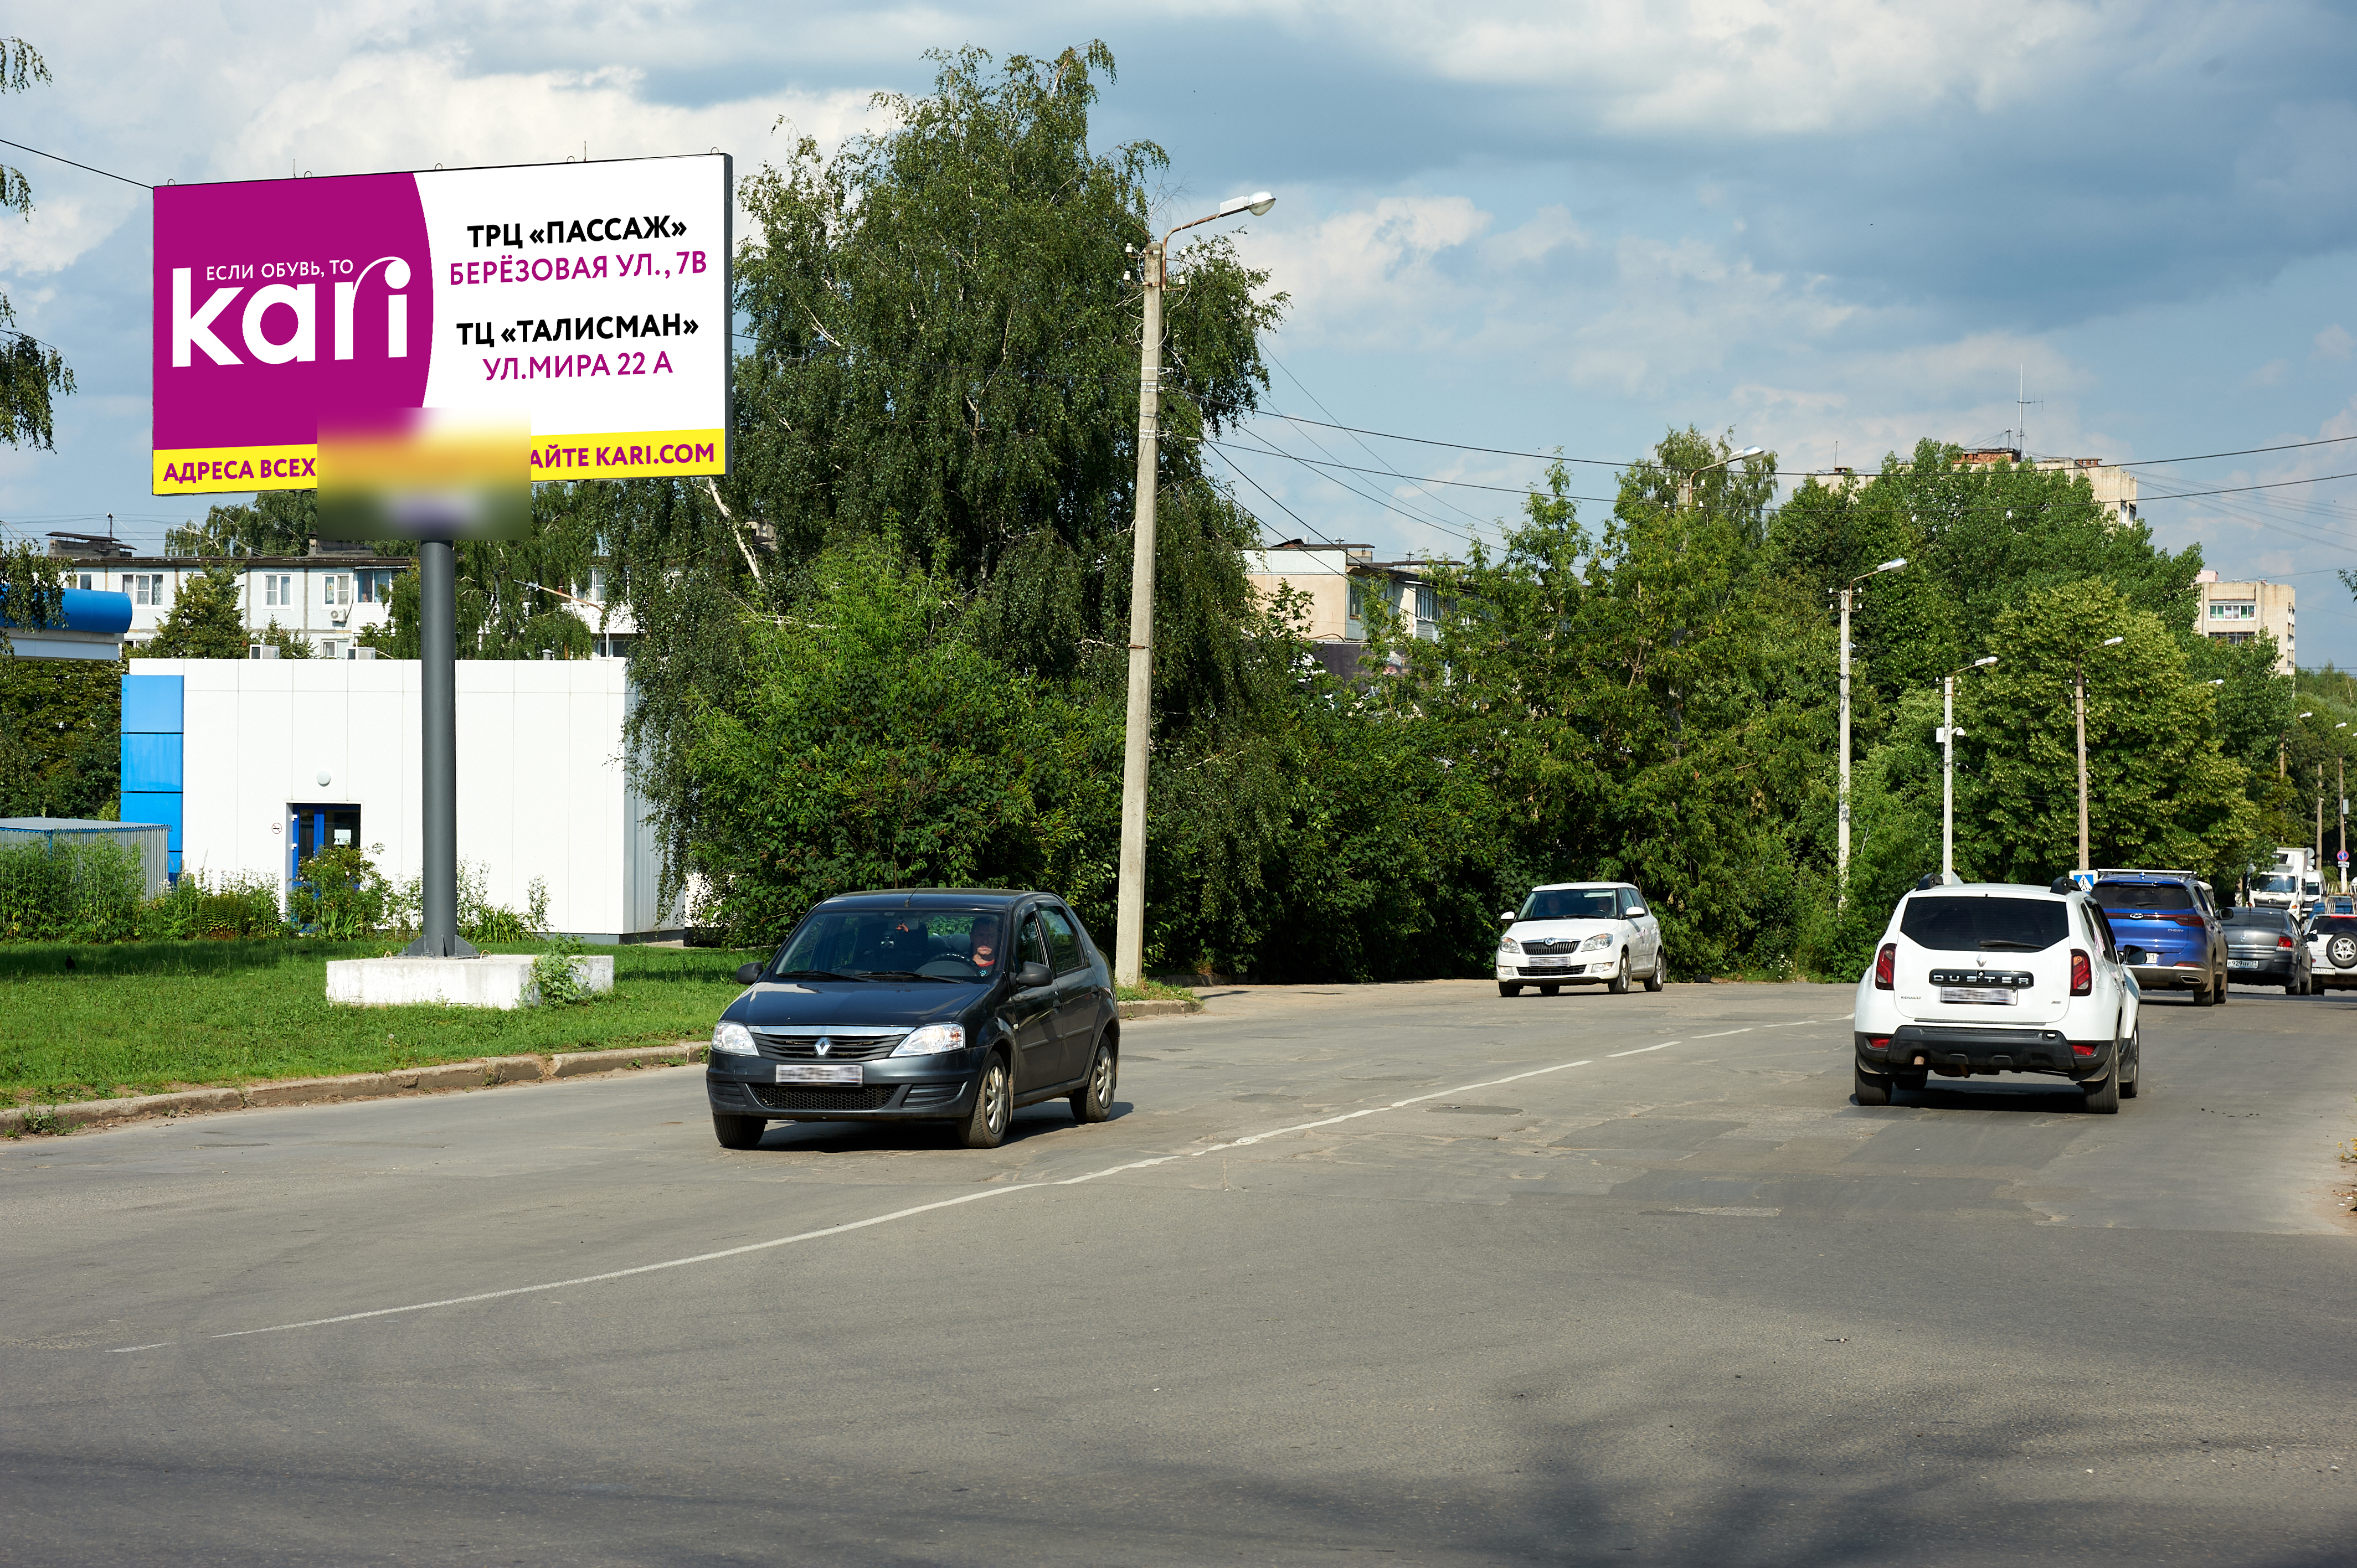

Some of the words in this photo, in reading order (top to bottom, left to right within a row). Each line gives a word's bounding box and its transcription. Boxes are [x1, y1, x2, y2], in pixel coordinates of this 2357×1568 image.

[467, 225, 523, 249] ТРЦ
[529, 220, 687, 245] «ПАССАЖ»
[207, 265, 253, 281] ЕСЛИ
[261, 261, 325, 278] ОБУВЬ,
[329, 259, 353, 276] ТО
[450, 255, 611, 285] БЕРЁЗОВАЯ
[676, 250, 707, 274] 7В
[172, 256, 411, 368] kari
[456, 322, 495, 348] ТЦ
[501, 313, 699, 343] «ТАЛИСМАН»
[617, 352, 646, 375] 22
[652, 350, 673, 374] А
[531, 444, 589, 468] АЙТЕ
[596, 443, 714, 466] KARI.COM
[163, 460, 255, 484] АДРЕСА
[260, 458, 316, 478] ВСЕХ
[1933, 974, 2029, 984] DUSTER
